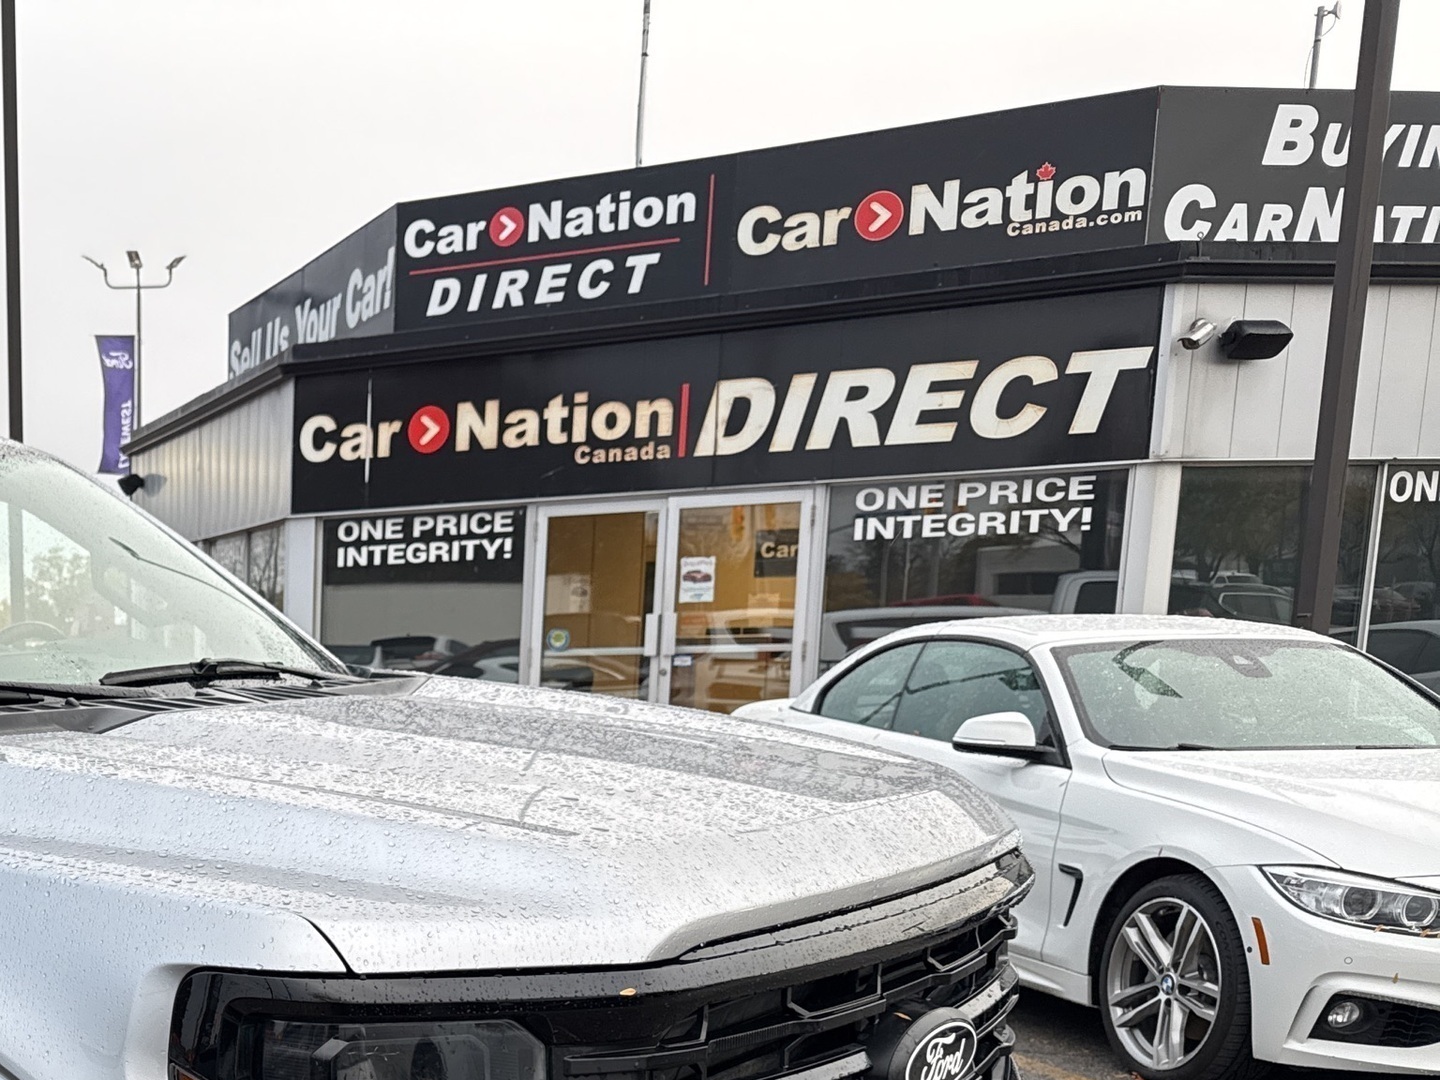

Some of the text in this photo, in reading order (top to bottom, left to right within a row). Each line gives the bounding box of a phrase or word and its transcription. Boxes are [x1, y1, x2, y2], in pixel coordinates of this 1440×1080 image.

[403, 190, 697, 259] Car Nation
[737, 165, 1147, 256] Car Nation
[1006, 206, 1143, 238] Canada.com
[426, 252, 661, 317] DIRECT
[229, 327, 263, 381] Sell
[295, 297, 342, 345] Your
[345, 246, 396, 330] Car!
[299, 346, 1154, 465] Car Nation DIRECT
[573, 442, 671, 466] Canada
[856, 475, 1096, 511] ONE PRICE
[1389, 470, 1440, 503] ON
[337, 511, 515, 543] ONE PRICE
[853, 507, 1093, 541] INTEGRITY!
[336, 538, 513, 568] INTEGRITY!
